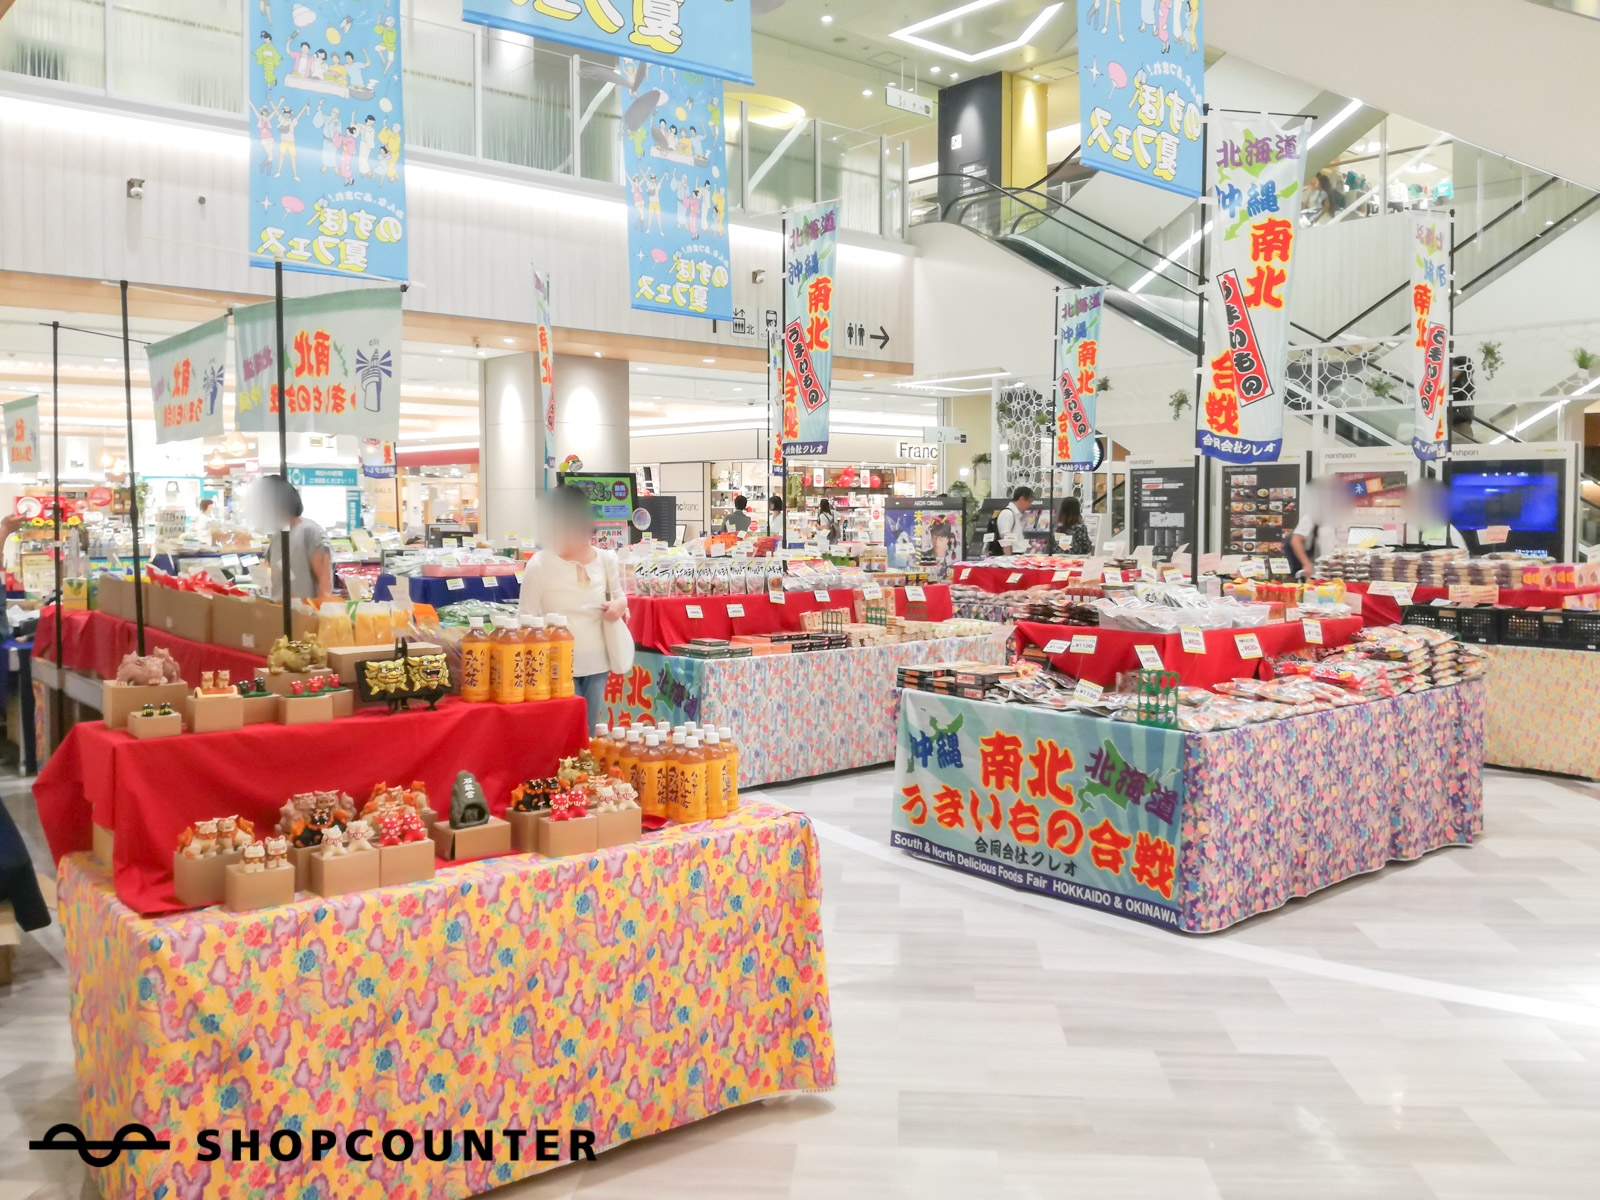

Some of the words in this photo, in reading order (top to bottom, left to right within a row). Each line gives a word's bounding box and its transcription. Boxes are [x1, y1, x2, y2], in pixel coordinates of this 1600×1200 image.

[1215, 133, 1301, 169] 北海道
[1214, 179, 1281, 219] 沖縄
[789, 210, 837, 252] 北海道
[788, 251, 819, 286] 沖縄
[1244, 217, 1293, 310] 南北
[806, 275, 832, 352] 南北
[1060, 320, 1088, 345] 沖縄
[1061, 292, 1102, 322] 北海道
[787, 324, 820, 406] うまいもの
[1222, 279, 1264, 396] うまいもの
[1076, 339, 1098, 396] 南北
[1060, 375, 1088, 436] うまいもの
[909, 730, 964, 769] 沖縄
[979, 730, 1076, 806] 南北
[1084, 746, 1179, 826] 北海道
[901, 783, 1177, 901] うまいもの合戦
[974, 836, 1079, 877] 合同会社クレオ
[894, 833, 923, 851] South
[924, 842, 931, 852] &
[932, 844, 956, 863] North
[957, 853, 997, 876] Delicious
[998, 864, 1024, 884] Foods
[1026, 872, 1048, 889] Fair
[1053, 880, 1111, 907] HOKKAIDO
[1114, 897, 1123, 909] &
[1125, 899, 1178, 925] OKINAWA
